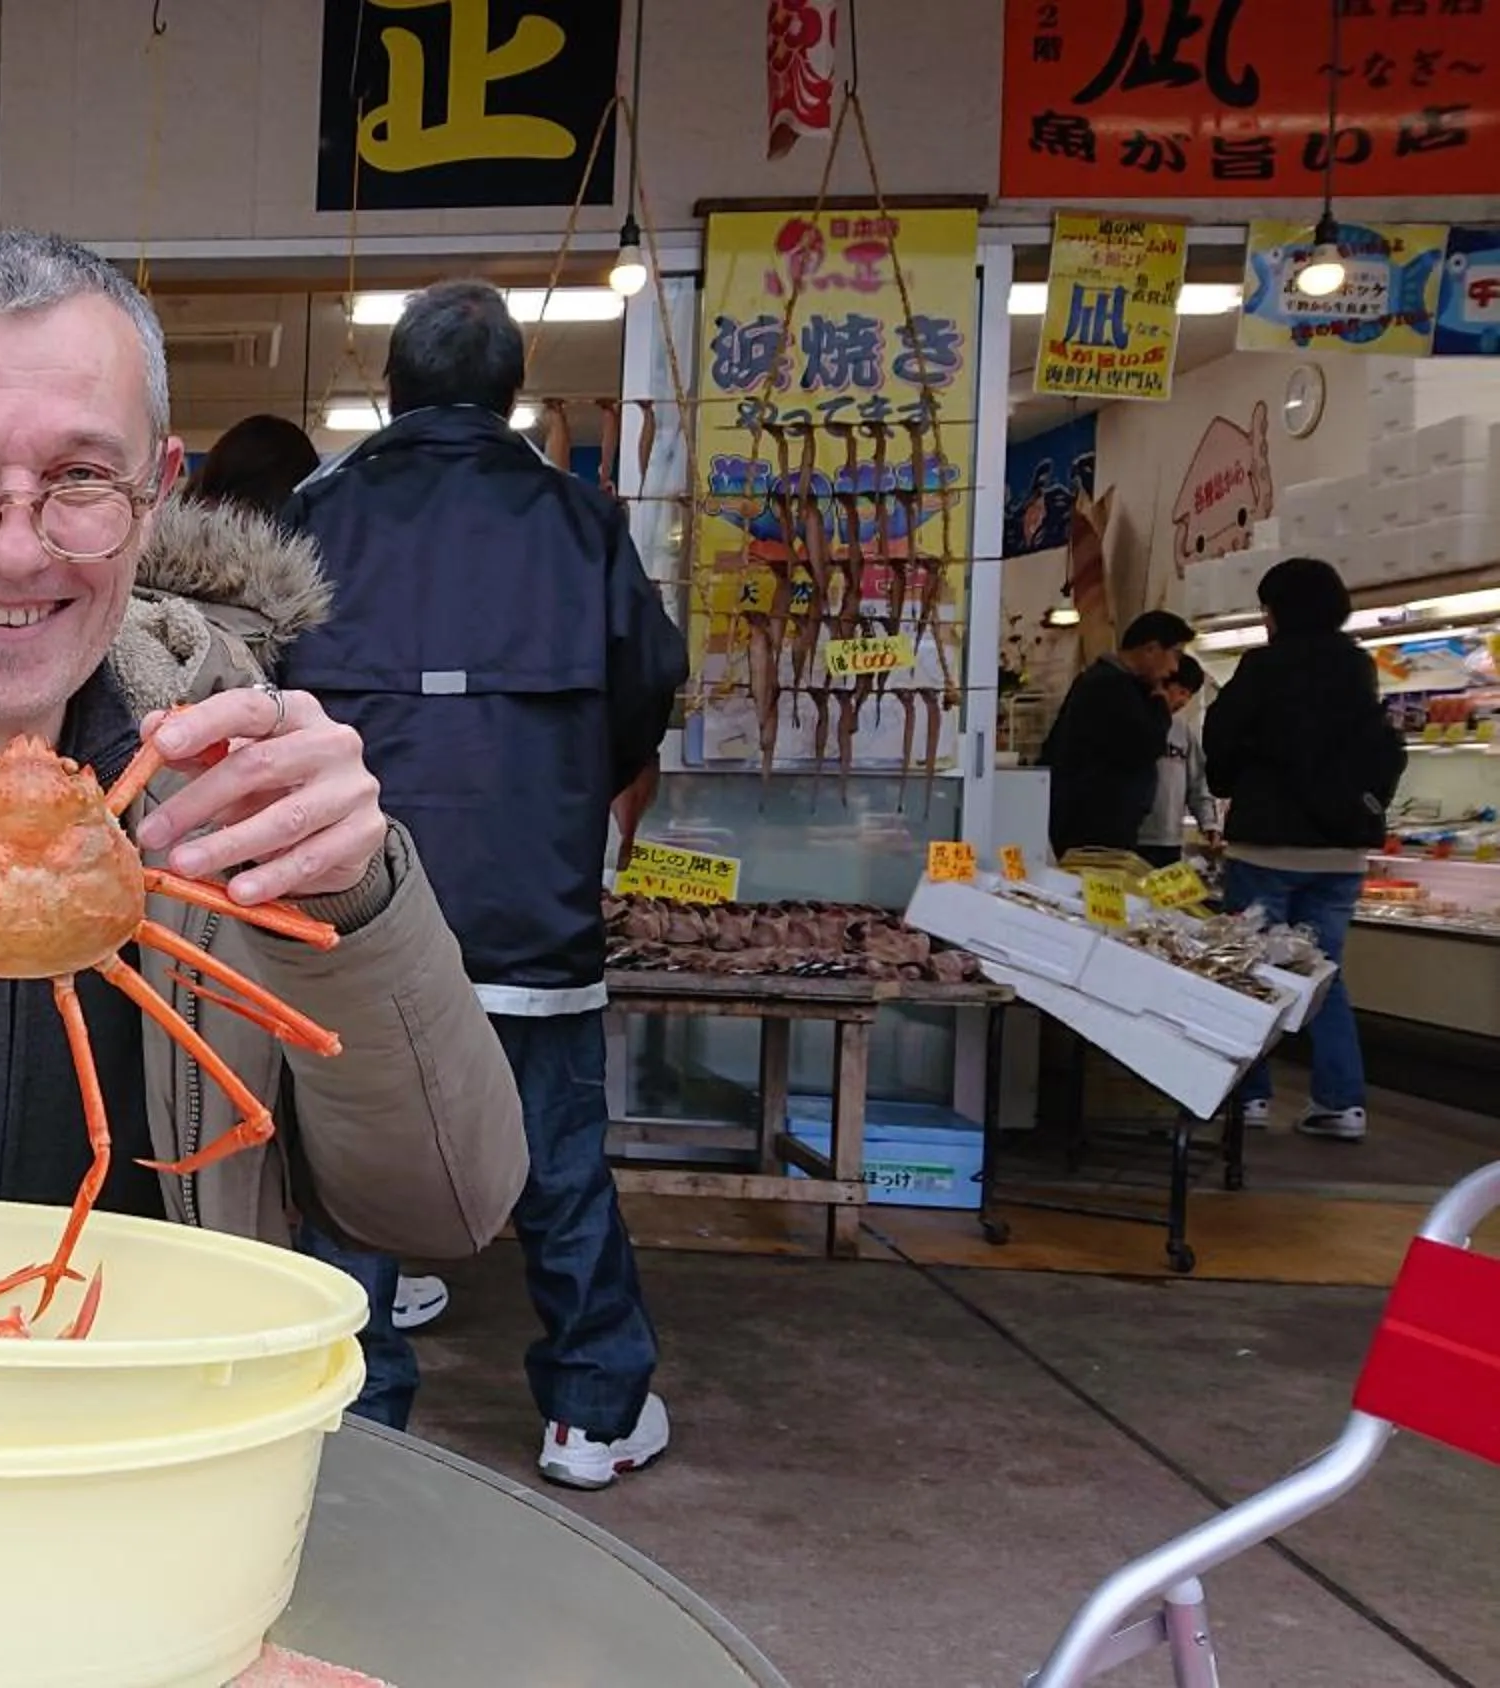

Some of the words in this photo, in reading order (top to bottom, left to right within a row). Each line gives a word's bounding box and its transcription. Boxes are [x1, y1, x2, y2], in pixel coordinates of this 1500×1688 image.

[357, 0, 577, 172] 正
[710, 313, 964, 392] 浜焼き
